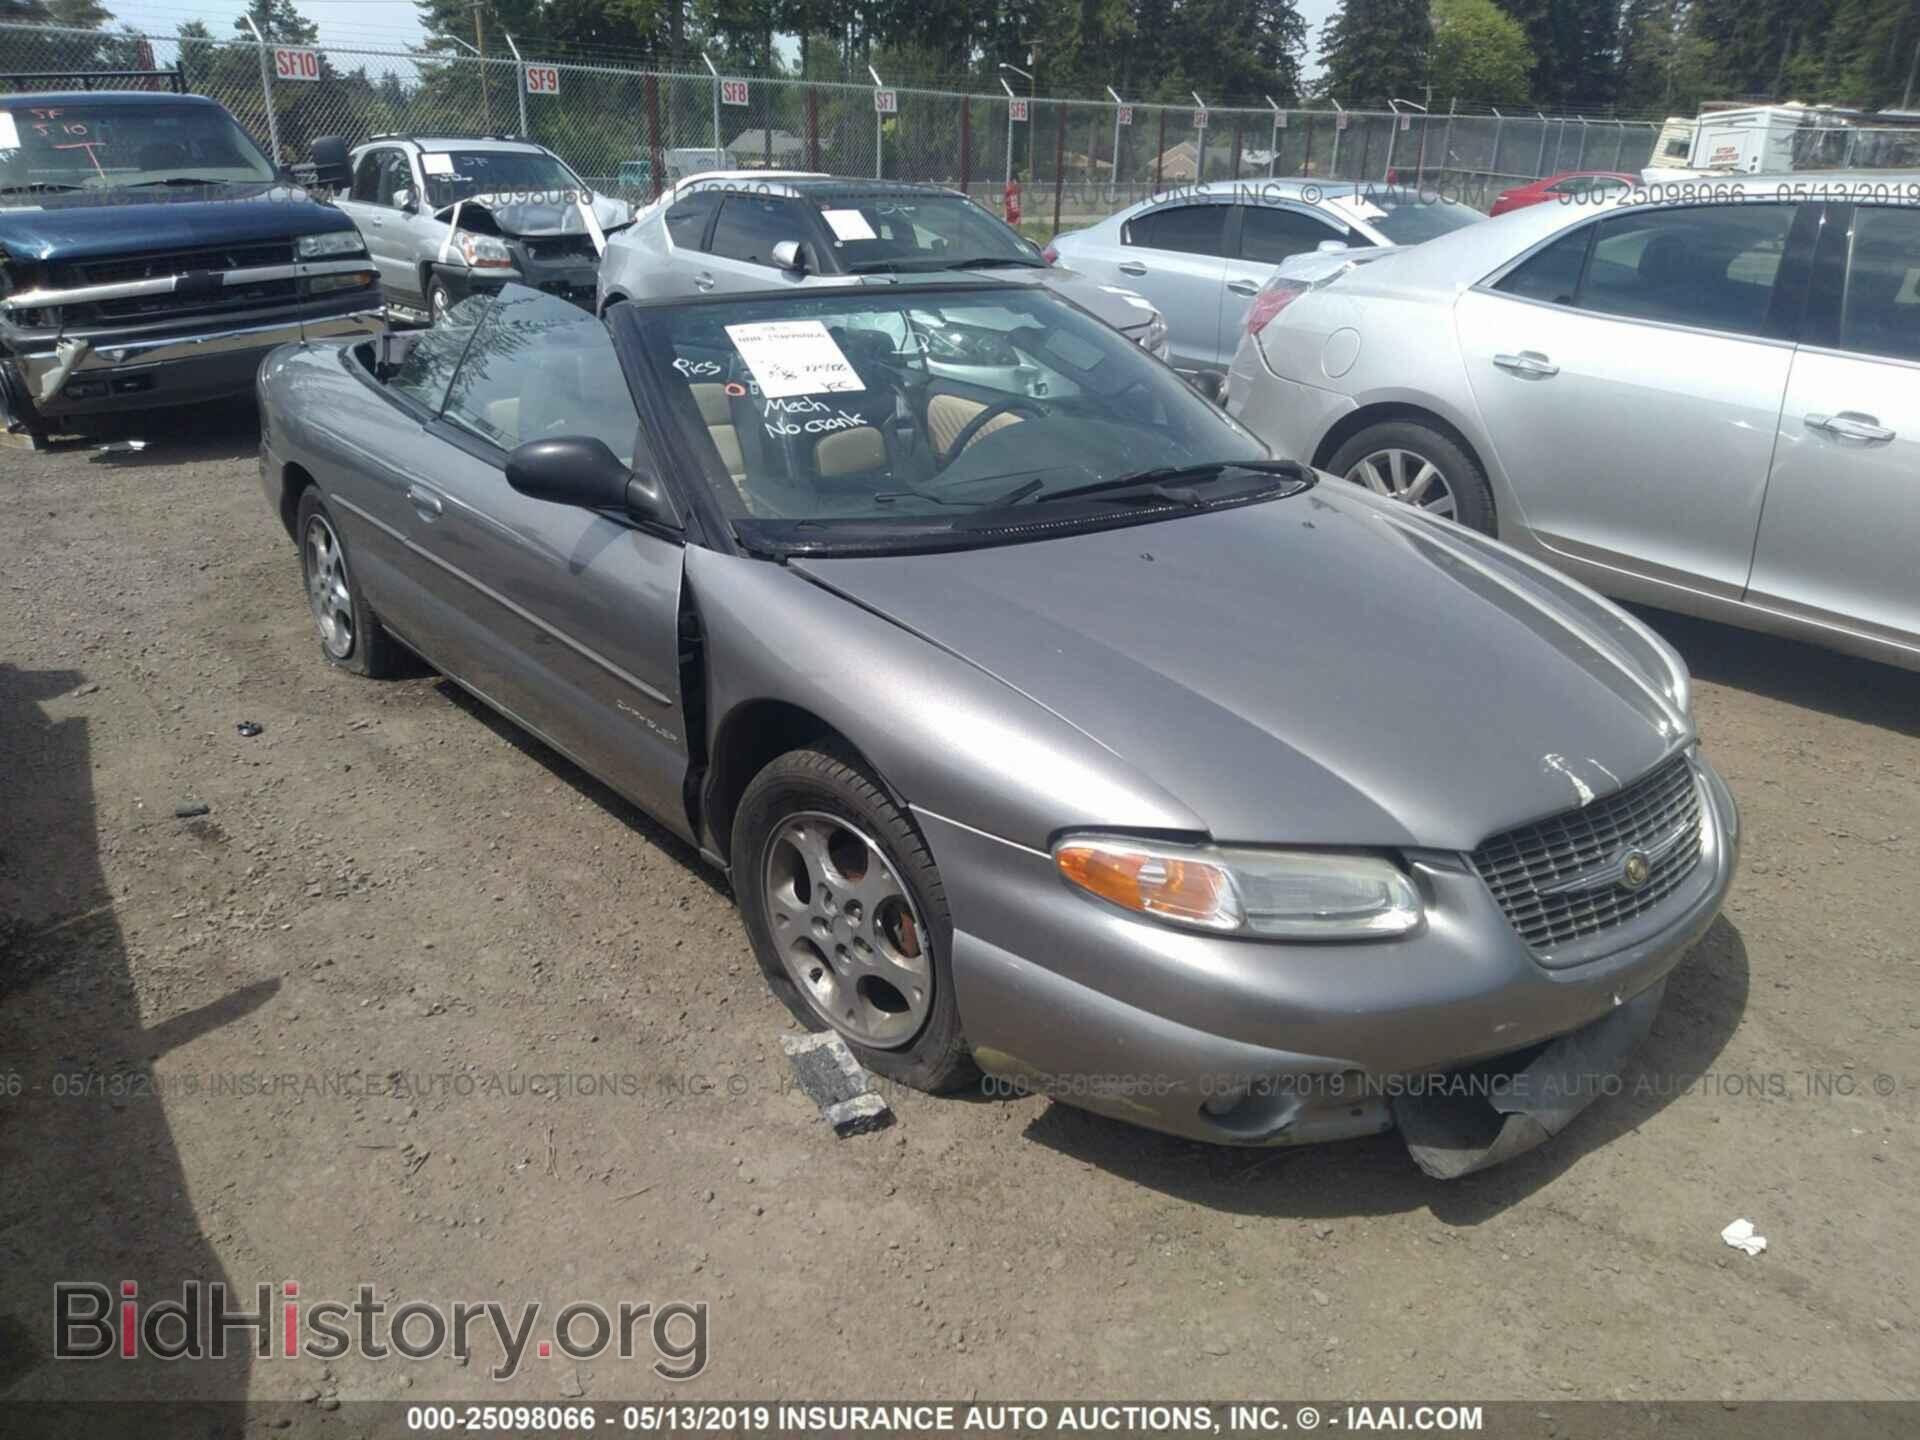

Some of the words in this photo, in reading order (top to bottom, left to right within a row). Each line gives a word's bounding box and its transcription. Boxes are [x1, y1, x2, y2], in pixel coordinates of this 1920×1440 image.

[276, 50, 318, 78] SF10
[527, 68, 558, 92] SF9
[722, 81, 747, 104] SF8
[875, 91, 895, 110] SF7
[1010, 101, 1026, 118] SF6
[764, 396, 831, 417] Mech
[764, 417, 801, 439] No
